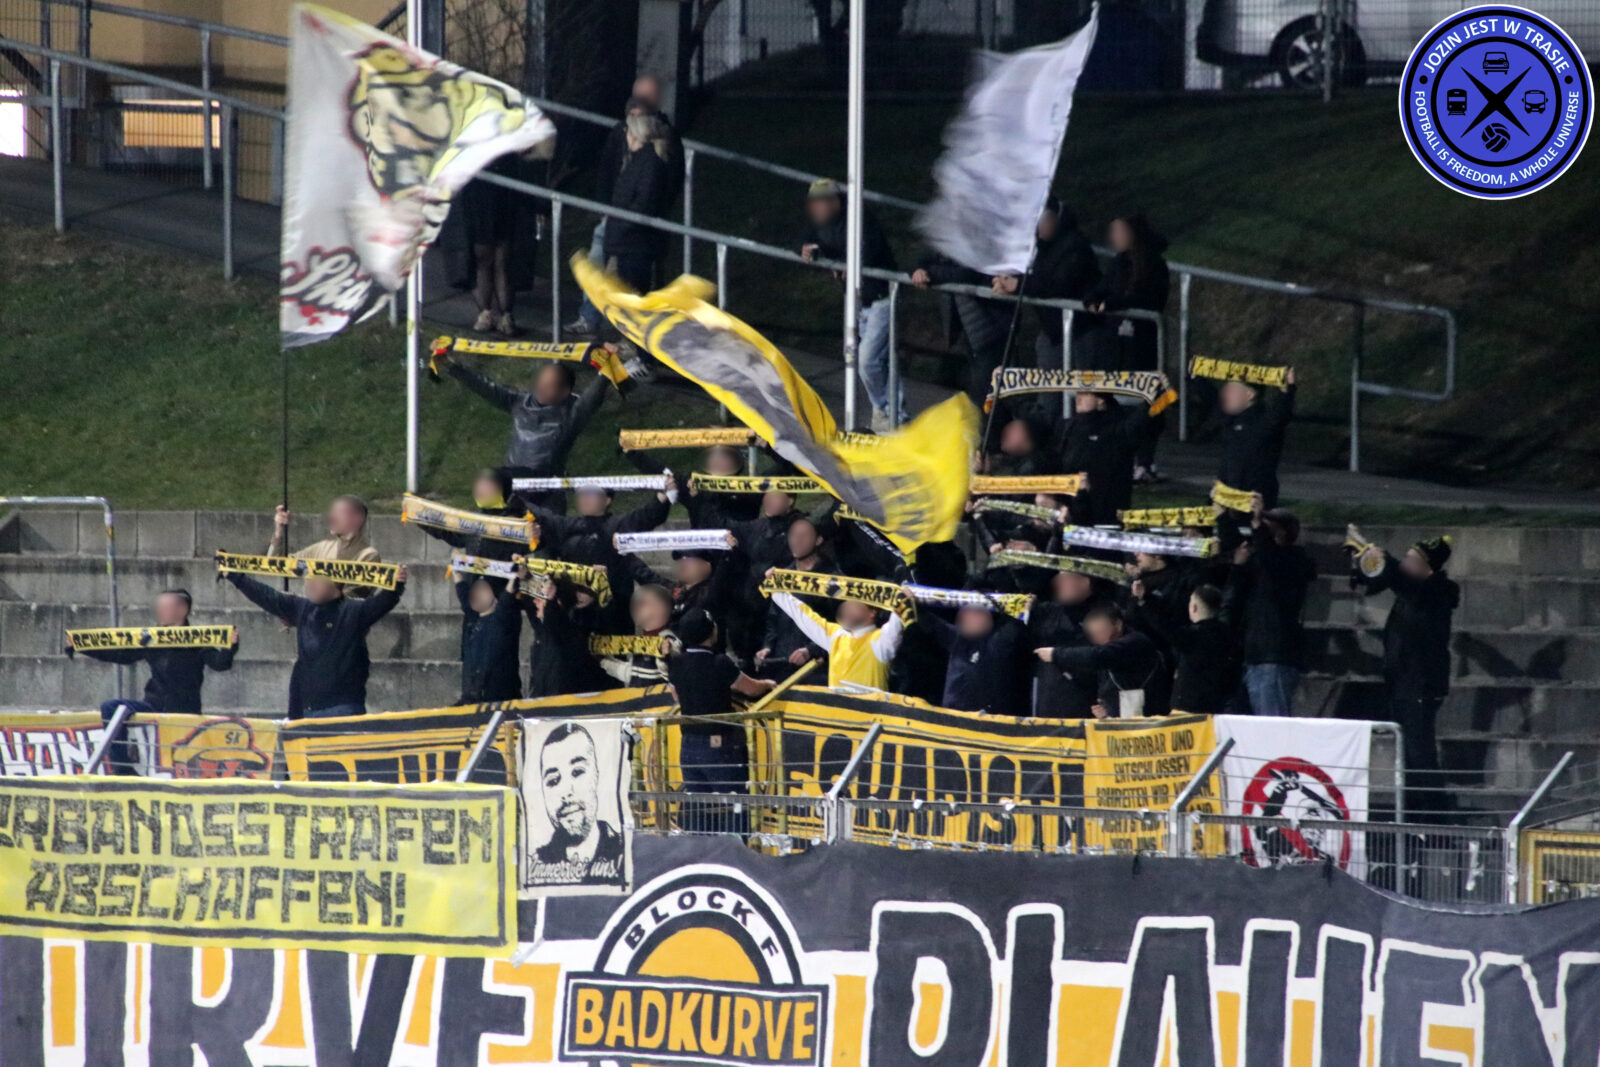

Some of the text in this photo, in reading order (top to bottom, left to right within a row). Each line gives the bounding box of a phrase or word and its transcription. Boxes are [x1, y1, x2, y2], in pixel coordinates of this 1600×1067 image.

[156, 628, 228, 645] ESKAPISTA
[1171, 729, 1194, 752] UND
[1114, 755, 1191, 784] ENTSCHLOSSEN
[624, 889, 779, 958] BLOCK F
[574, 987, 815, 1060] BADKURVE
